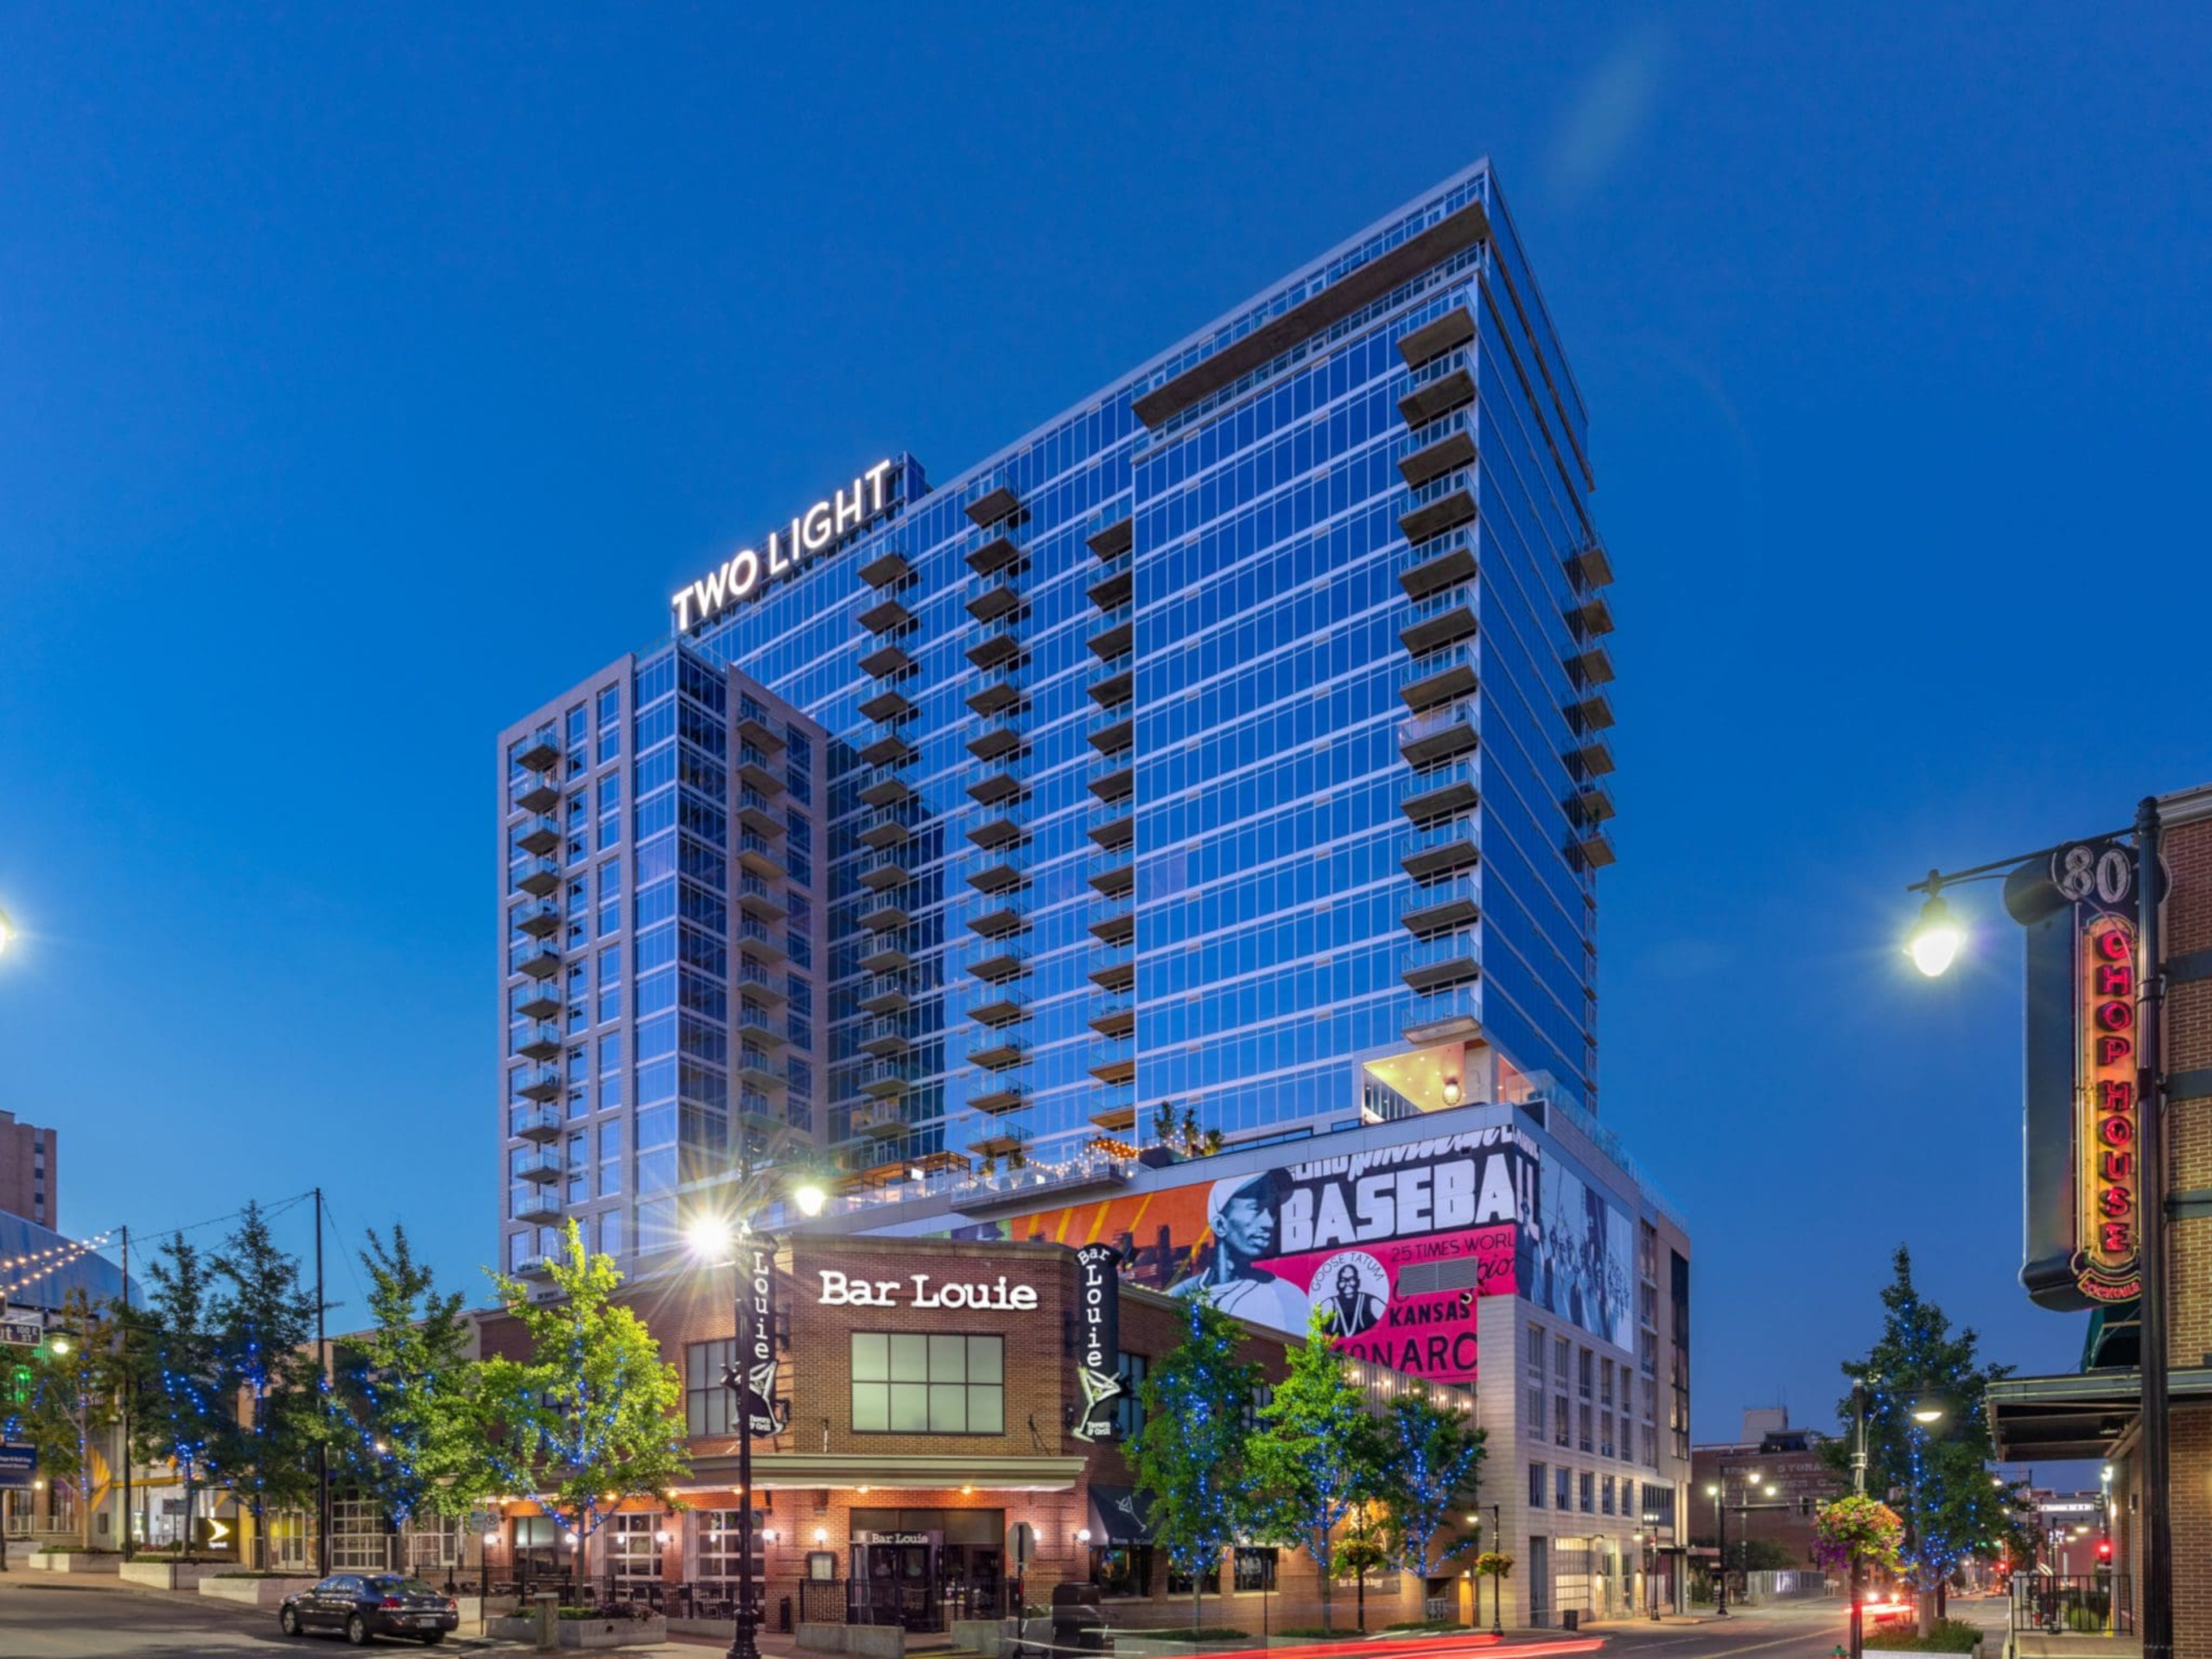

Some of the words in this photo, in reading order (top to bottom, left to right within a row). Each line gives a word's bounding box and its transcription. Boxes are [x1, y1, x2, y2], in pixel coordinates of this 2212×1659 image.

[672, 550, 759, 632] TWO
[769, 460, 891, 575] LIGHT
[2063, 846, 2139, 904] 80
[1077, 1248, 1110, 1266] Bar
[1391, 1248, 1413, 1262] 25
[1415, 1239, 1460, 1260] TIMES
[817, 1269, 901, 1306] Bar
[910, 1274, 1039, 1310] Louie
[1311, 1253, 1346, 1293] GOOSE
[1350, 1253, 1385, 1281] TATUM
[753, 1251, 770, 1360] Louie
[1085, 1264, 1103, 1367] Louie
[1389, 1300, 1471, 1327] KANSAS
[1333, 1332, 1478, 1374] ONARC
[872, 1533, 893, 1543] Bar
[894, 1533, 929, 1543] Louie
